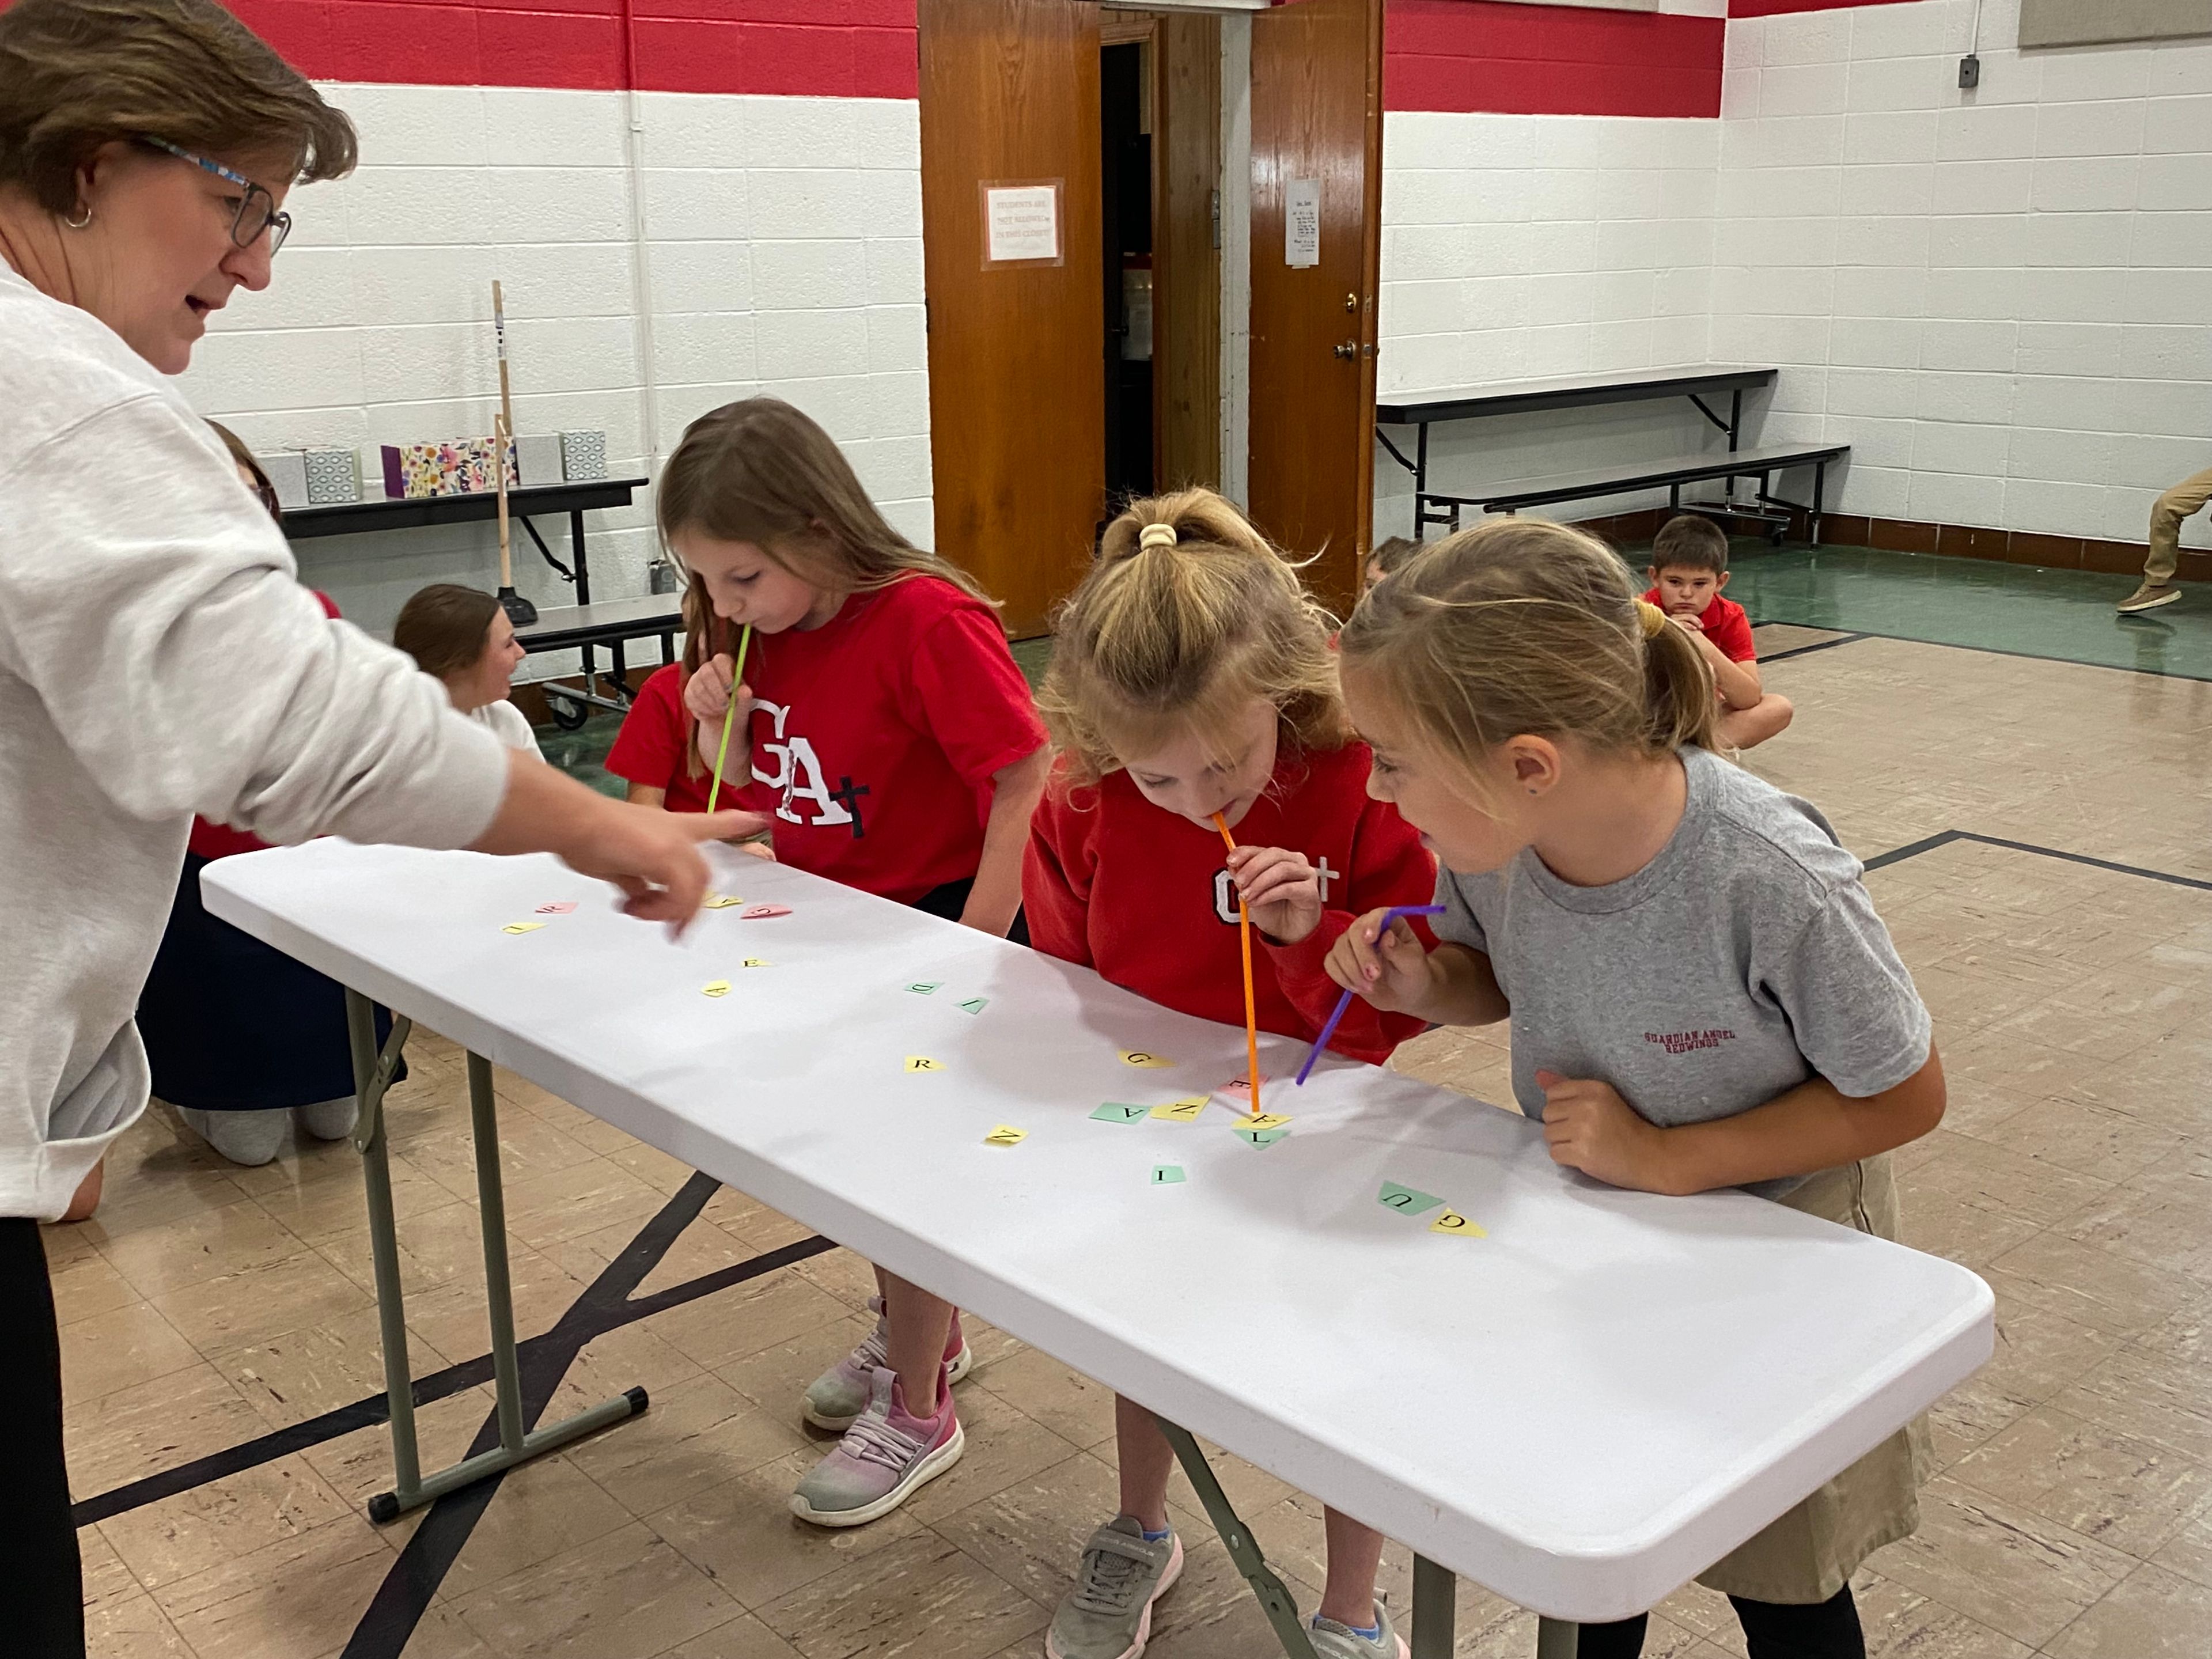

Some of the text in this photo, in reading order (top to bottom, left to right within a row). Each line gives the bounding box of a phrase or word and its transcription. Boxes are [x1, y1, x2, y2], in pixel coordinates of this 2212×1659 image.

[1644, 1029, 1736, 1044] GUARDIAN ANGEL
[1665, 1039, 1719, 1054] REDWINGS
[912, 1059, 933, 1069] R
[1124, 1107, 1144, 1118] A
